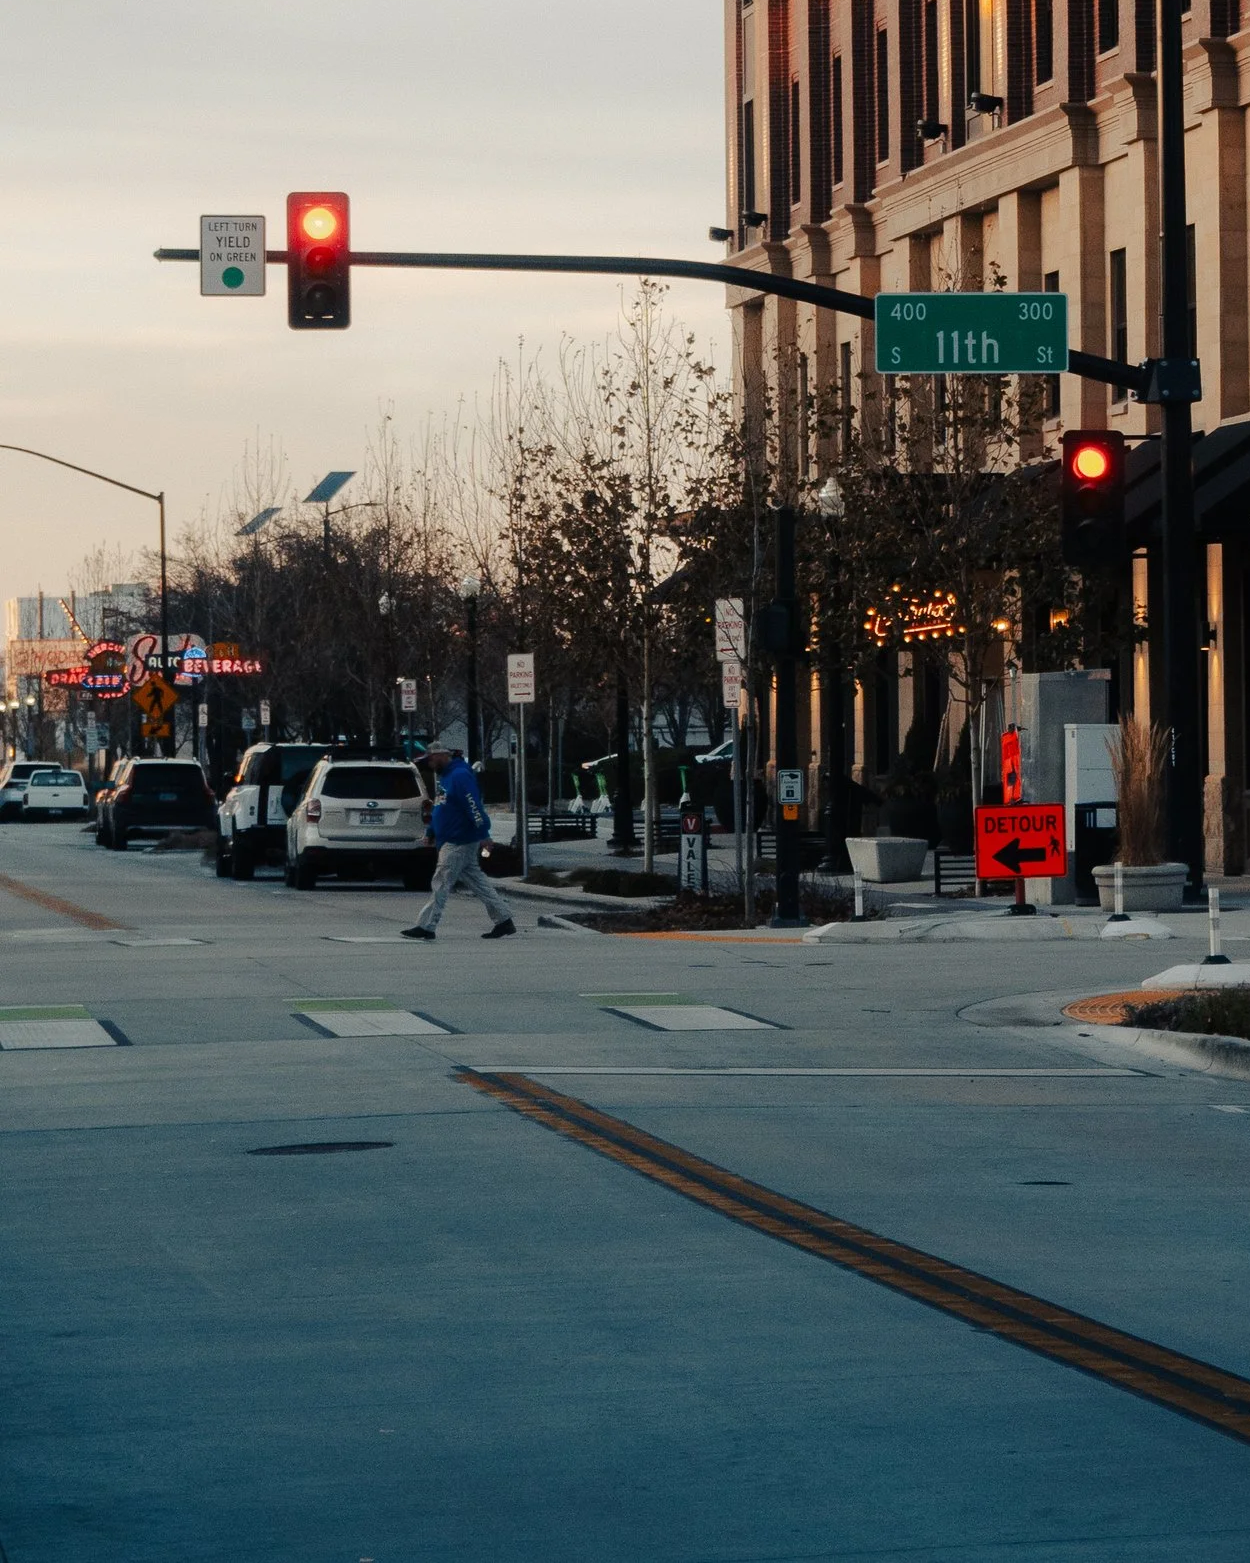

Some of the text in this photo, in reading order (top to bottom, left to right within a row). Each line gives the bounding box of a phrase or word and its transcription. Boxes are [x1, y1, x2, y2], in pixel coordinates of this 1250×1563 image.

[208, 222, 258, 232] LEFT TURN
[216, 236, 251, 248] YIELD
[209, 252, 258, 262] ON GREEN
[890, 302, 1053, 321] 400 300
[891, 330, 1053, 364] S 11th St
[516, 660, 526, 669] NO
[509, 671, 533, 679] PARKING
[686, 818, 697, 831] V
[984, 815, 1058, 834] DETOUR
[685, 837, 696, 887] VALE
